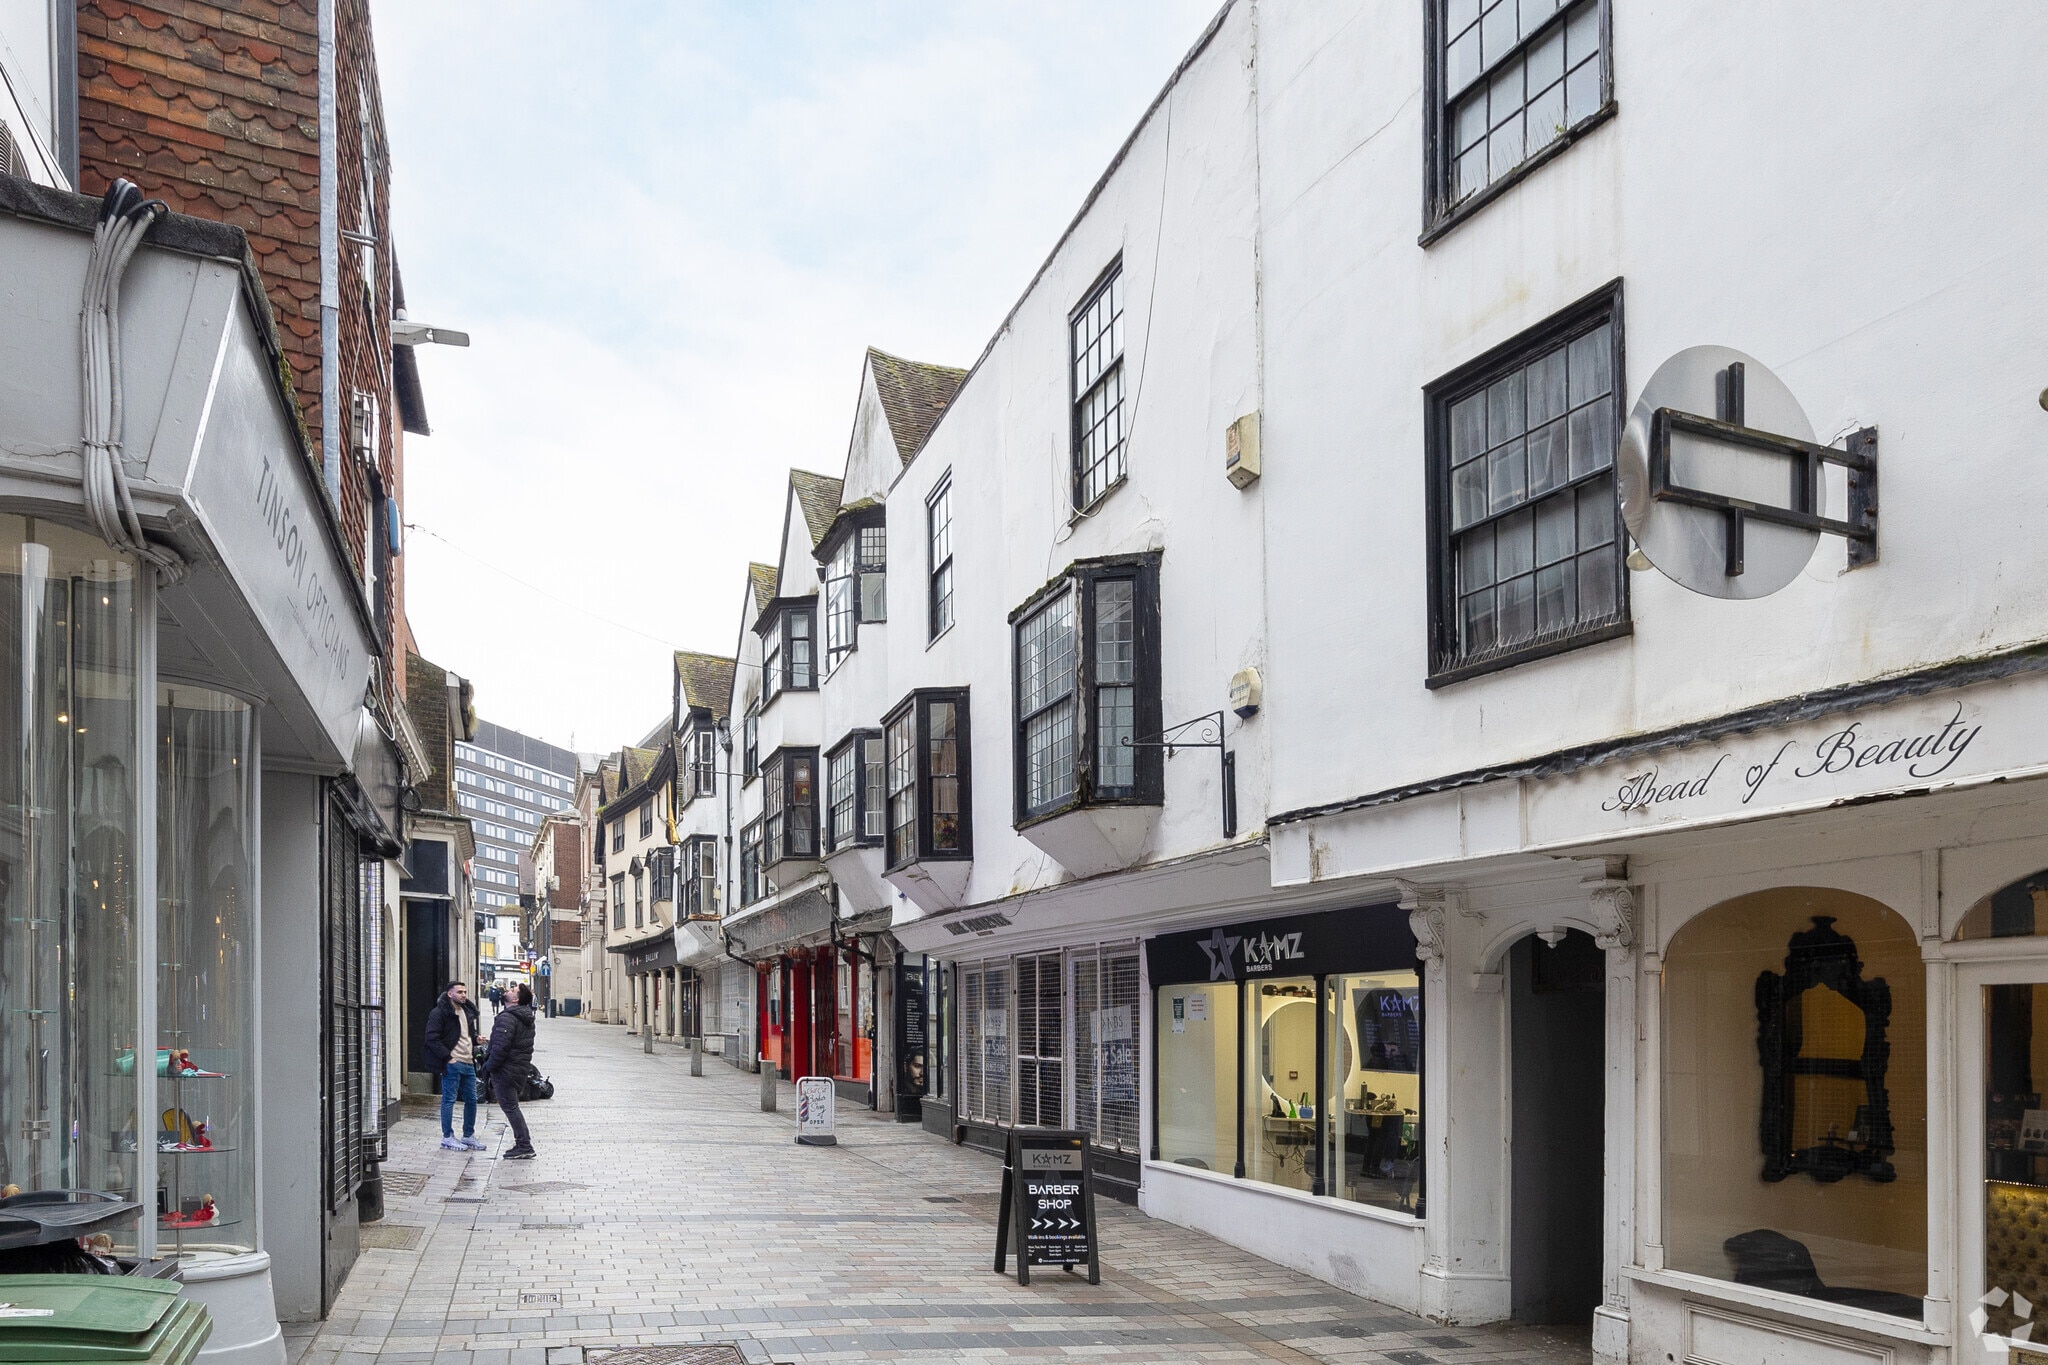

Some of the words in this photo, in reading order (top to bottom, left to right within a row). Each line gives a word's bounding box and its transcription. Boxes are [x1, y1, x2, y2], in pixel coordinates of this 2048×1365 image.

[256, 455, 308, 588] TINSON
[306, 572, 350, 680] OPTICIANS
[1601, 753, 1732, 812] Ahead
[1742, 740, 1796, 804] of
[1794, 701, 1982, 778] Beauty
[1246, 963, 1273, 973] BARBERS
[1110, 1043, 1132, 1064] Sale
[1028, 1184, 1079, 1195] BARBER
[1037, 1199, 1072, 1209] SHOP
